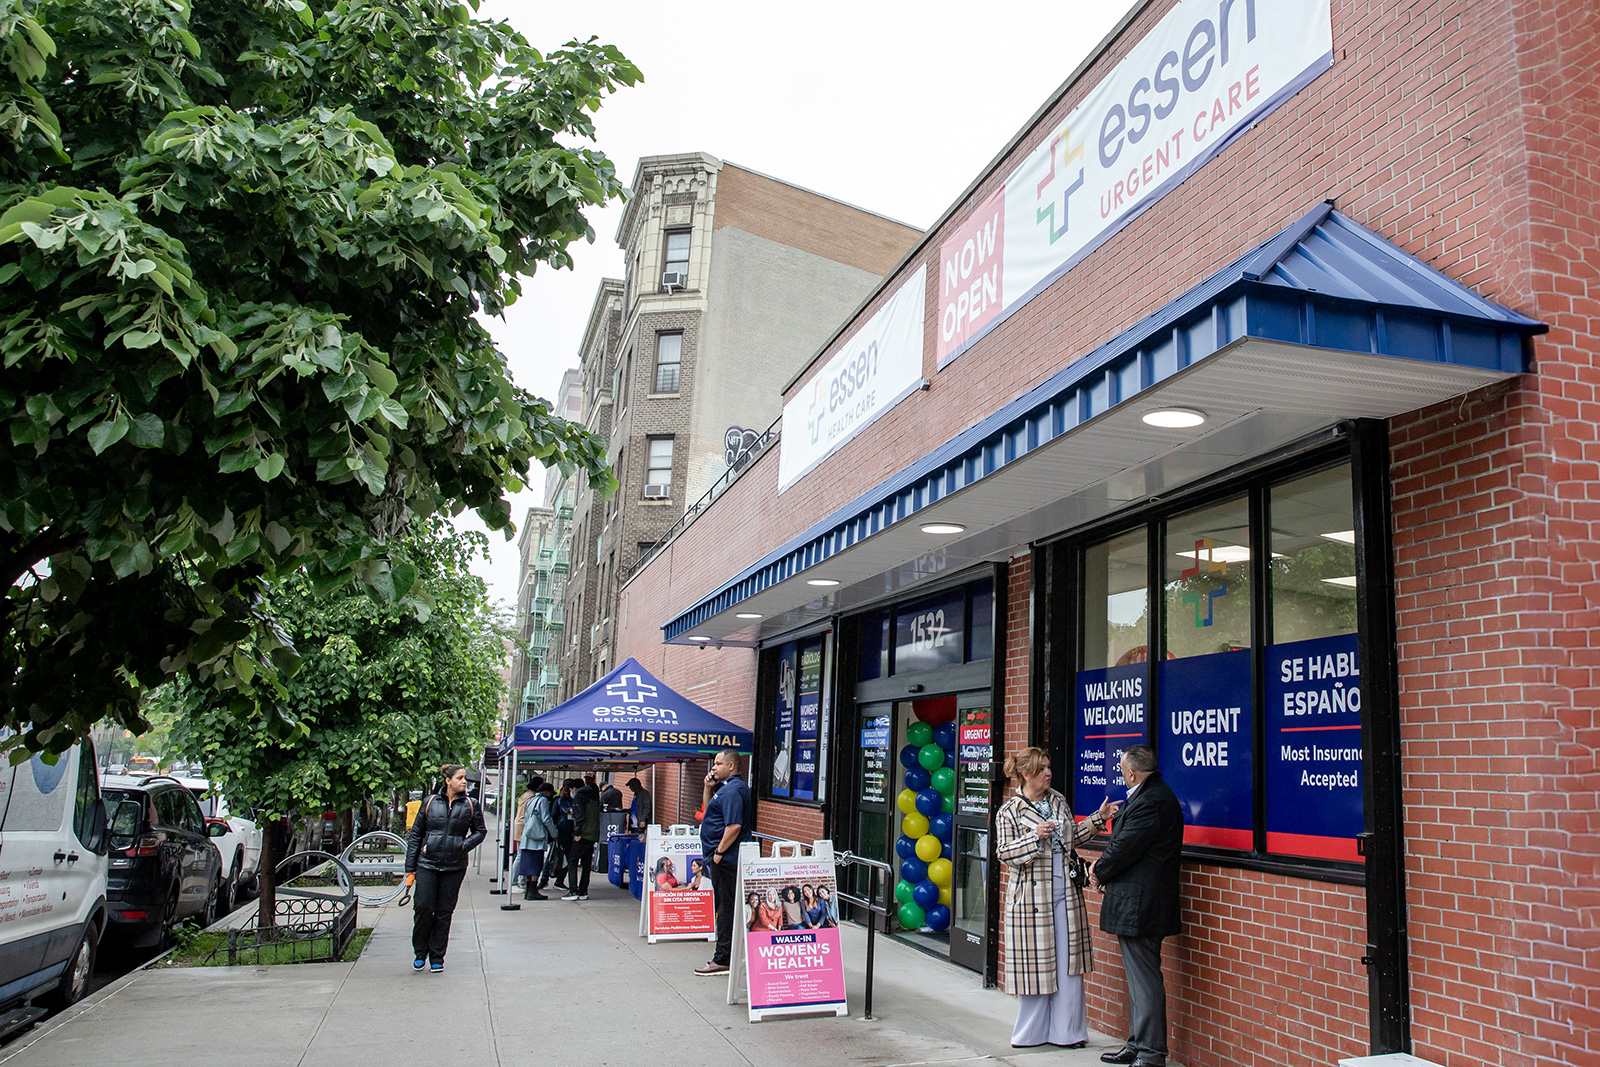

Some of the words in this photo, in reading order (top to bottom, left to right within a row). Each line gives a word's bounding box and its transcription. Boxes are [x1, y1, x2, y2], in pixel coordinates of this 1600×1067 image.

[1098, 0, 1257, 168] essen
[1100, 128, 1184, 219] URGENT
[1192, 64, 1262, 144] CARE
[945, 212, 1000, 298] NOW
[942, 264, 998, 342] OPEN
[829, 337, 879, 413] essen
[827, 408, 854, 443] HEALTH
[855, 390, 876, 424] CARE
[910, 609, 944, 652] 1532
[1281, 658, 1304, 683] SE
[1308, 651, 1360, 680] HABL
[1085, 677, 1143, 702] WALK-INS
[1284, 682, 1361, 716] ESPAÑO
[592, 706, 677, 719] essen
[1084, 703, 1144, 726] WELCOME
[1172, 707, 1241, 735] URGENT
[801, 720, 816, 731] HEALTH
[964, 729, 983, 739] URGENT
[530, 729, 573, 742] YOUR
[577, 730, 638, 742] HEALTH
[641, 730, 656, 742] IS
[659, 731, 740, 747] ESSENTIAL
[1084, 750, 1105, 760] Allergies
[1182, 741, 1228, 767] CARE
[1281, 745, 1310, 761] Most
[1084, 763, 1103, 772] Asthma
[1092, 776, 1107, 785] Shots
[1301, 770, 1358, 790] Accepted
[758, 943, 830, 958] WOMEN'S
[776, 935, 812, 943] WALK-IN
[767, 956, 824, 970] HEALTH
